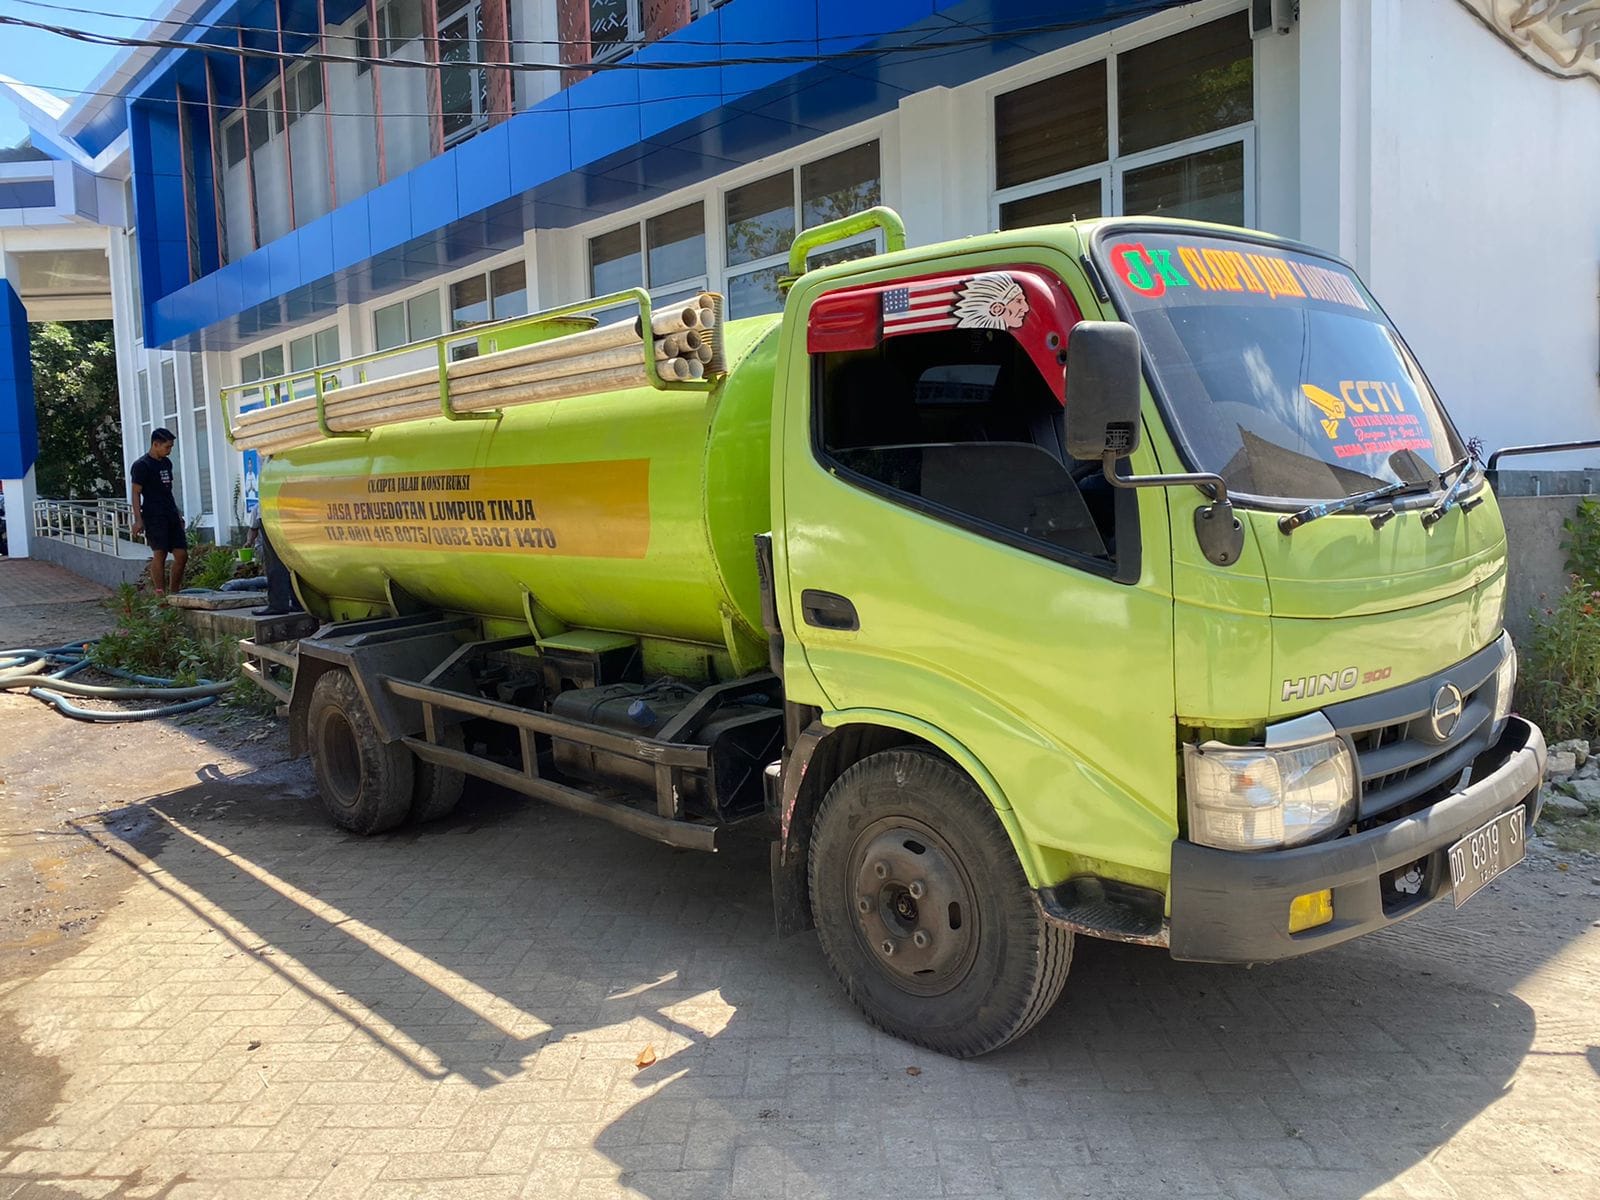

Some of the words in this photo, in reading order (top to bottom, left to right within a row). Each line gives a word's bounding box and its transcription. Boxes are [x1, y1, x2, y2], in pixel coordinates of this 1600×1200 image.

[1339, 380, 1405, 413] CCTV
[397, 477, 419, 493] JALAH
[421, 475, 470, 491] KONSTRUKSI
[326, 503, 352, 520] JASA
[352, 501, 427, 520] PENYEDOTAN
[429, 501, 486, 521] LUMPUR
[487, 500, 536, 521] TINJA
[373, 526, 395, 542] 415
[470, 527, 512, 547] 5587
[513, 527, 558, 549] 1470
[1281, 666, 1358, 702] HINO
[1361, 666, 1393, 684] 300
[1451, 847, 1466, 888] DD
[1471, 824, 1499, 870] 8319
[1509, 808, 1525, 845] ST
